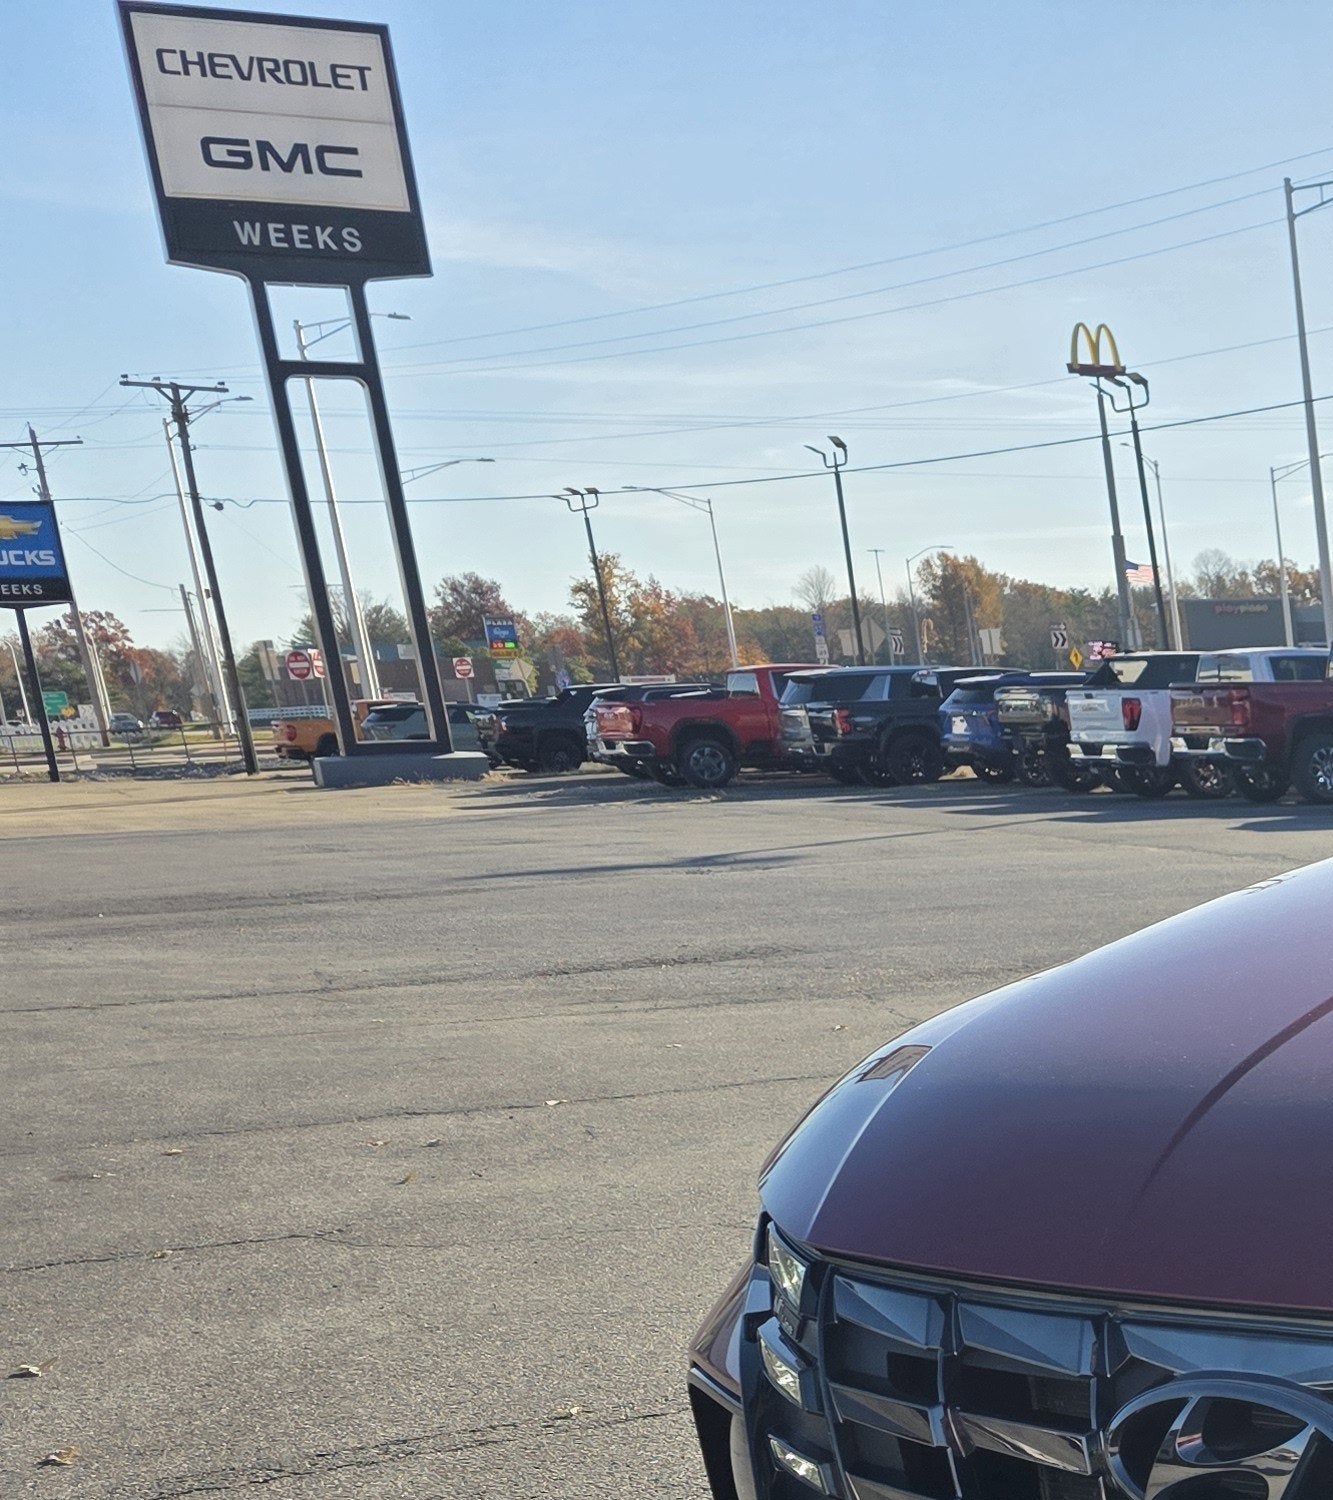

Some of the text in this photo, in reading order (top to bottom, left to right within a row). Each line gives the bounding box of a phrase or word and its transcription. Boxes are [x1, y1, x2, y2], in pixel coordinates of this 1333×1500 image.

[156, 48, 372, 91] CHEVROLET
[200, 136, 363, 178] GMC
[233, 220, 363, 252] WEEKS
